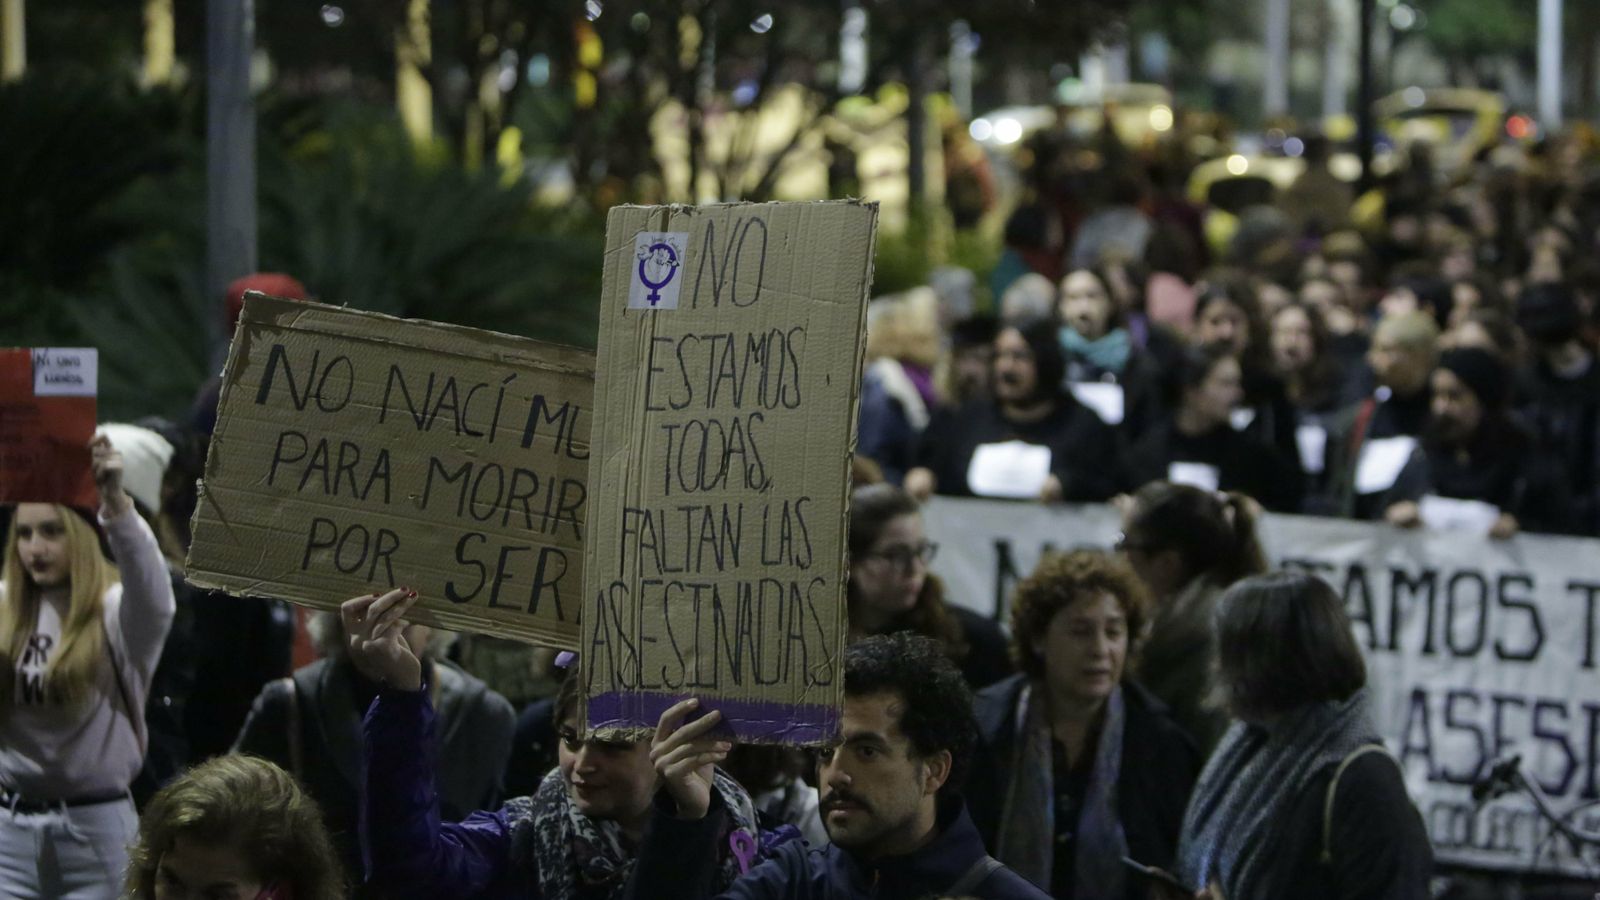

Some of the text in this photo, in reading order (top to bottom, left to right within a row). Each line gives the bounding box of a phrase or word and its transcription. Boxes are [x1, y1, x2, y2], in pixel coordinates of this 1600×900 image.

[691, 216, 768, 310] NO
[254, 343, 355, 413] NO
[378, 372, 519, 444] NACÍ
[645, 326, 804, 412] ESTAMOS
[267, 430, 588, 541] PARA MORIR
[302, 516, 568, 622] POR SER
[619, 496, 812, 578] FALTAN LAS
[586, 576, 833, 698] ASESINADAS
[1279, 558, 1547, 662] AMOS
